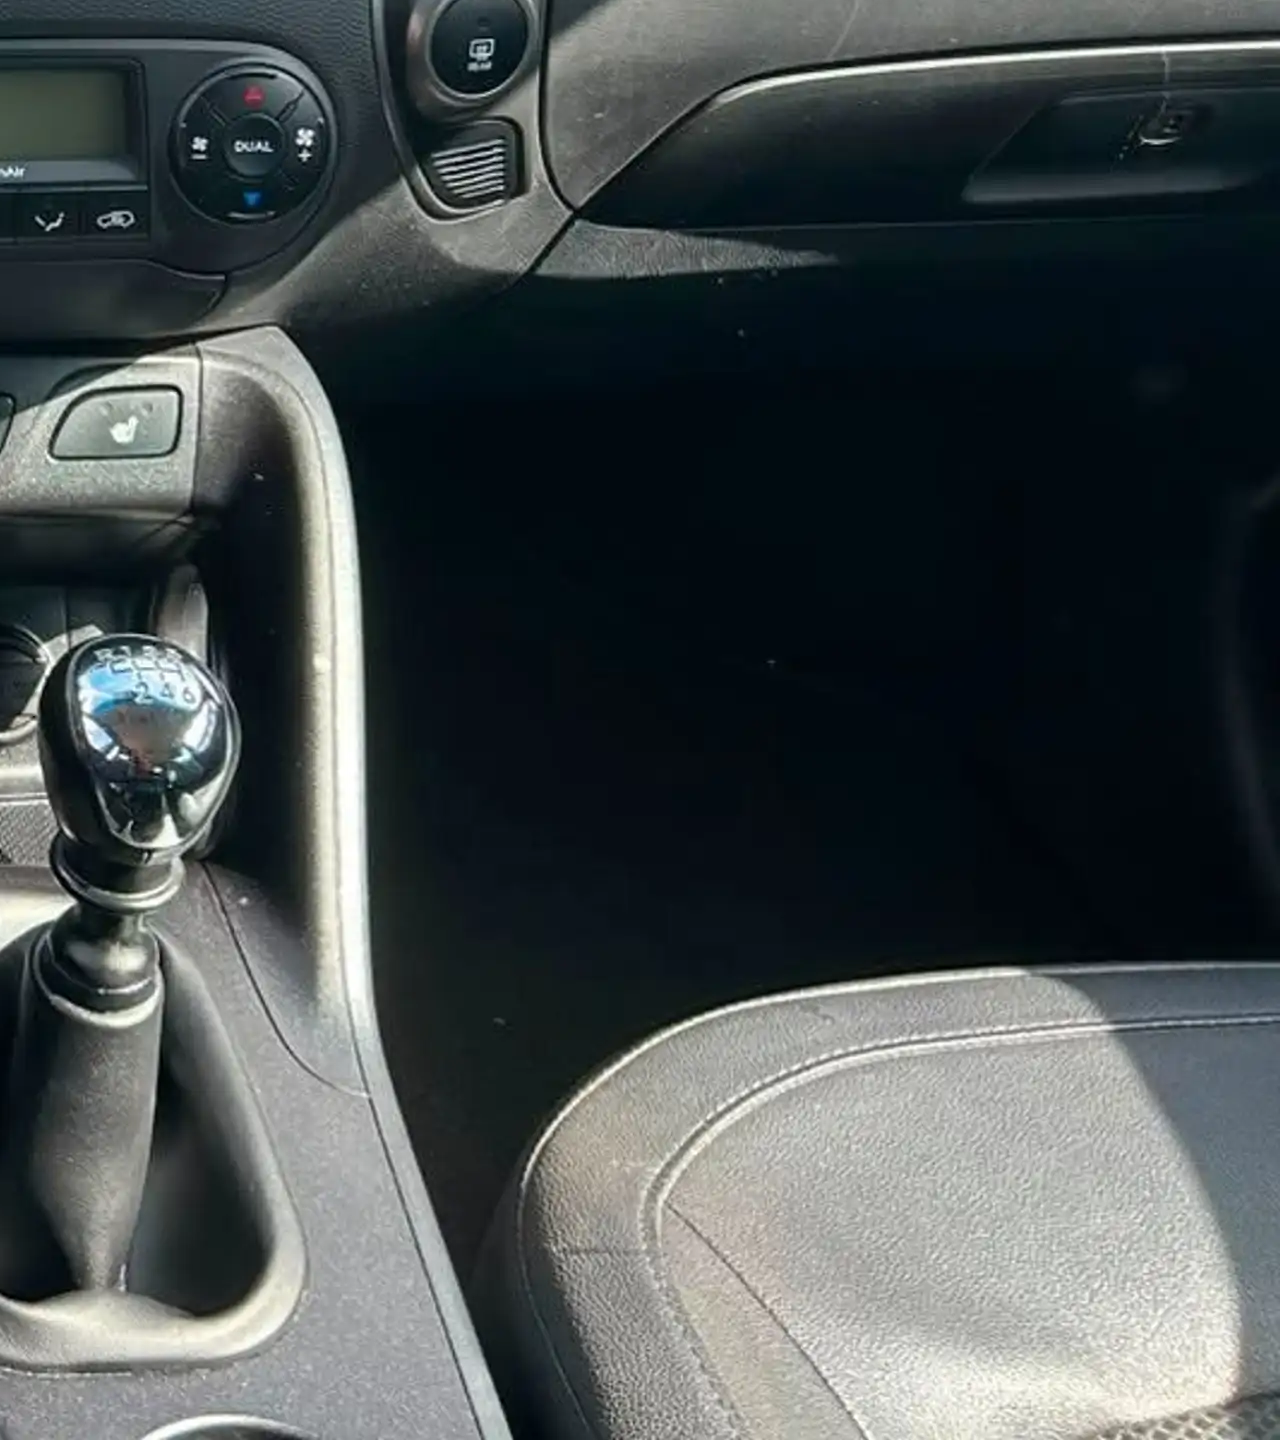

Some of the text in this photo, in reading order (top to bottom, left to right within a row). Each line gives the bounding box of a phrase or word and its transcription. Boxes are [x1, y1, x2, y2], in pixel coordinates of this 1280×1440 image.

[234, 141, 274, 153] DUAL
[134, 681, 154, 704] 2
[183, 686, 196, 705] 6
